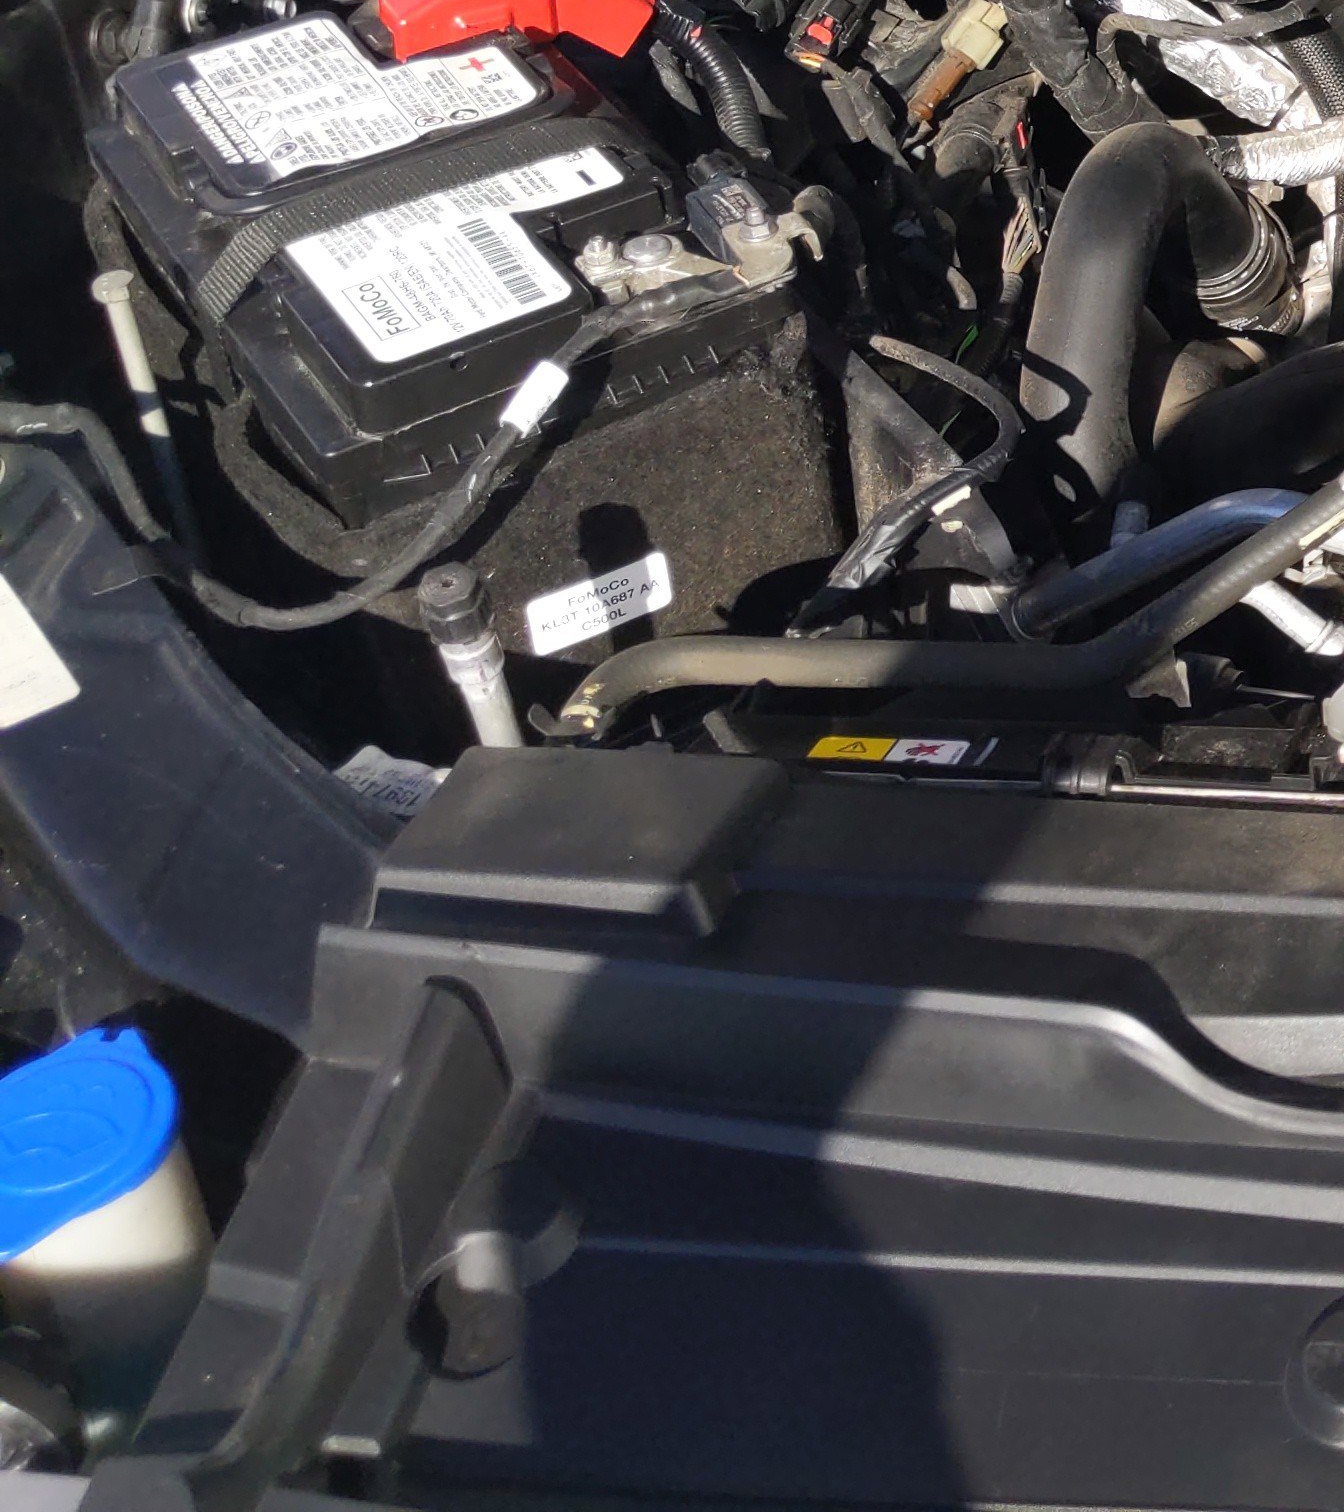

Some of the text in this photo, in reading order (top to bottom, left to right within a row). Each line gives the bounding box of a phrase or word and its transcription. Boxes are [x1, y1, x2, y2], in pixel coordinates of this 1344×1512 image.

[175, 89, 239, 159] DANGER/POISON
[194, 87, 260, 159] PELIGRO/VENENO
[359, 283, 409, 335] FoMoCo
[541, 609, 579, 632] KL3T
[585, 588, 635, 616] 10A687
[567, 577, 630, 607] FoMoCo
[581, 608, 627, 631] C500L
